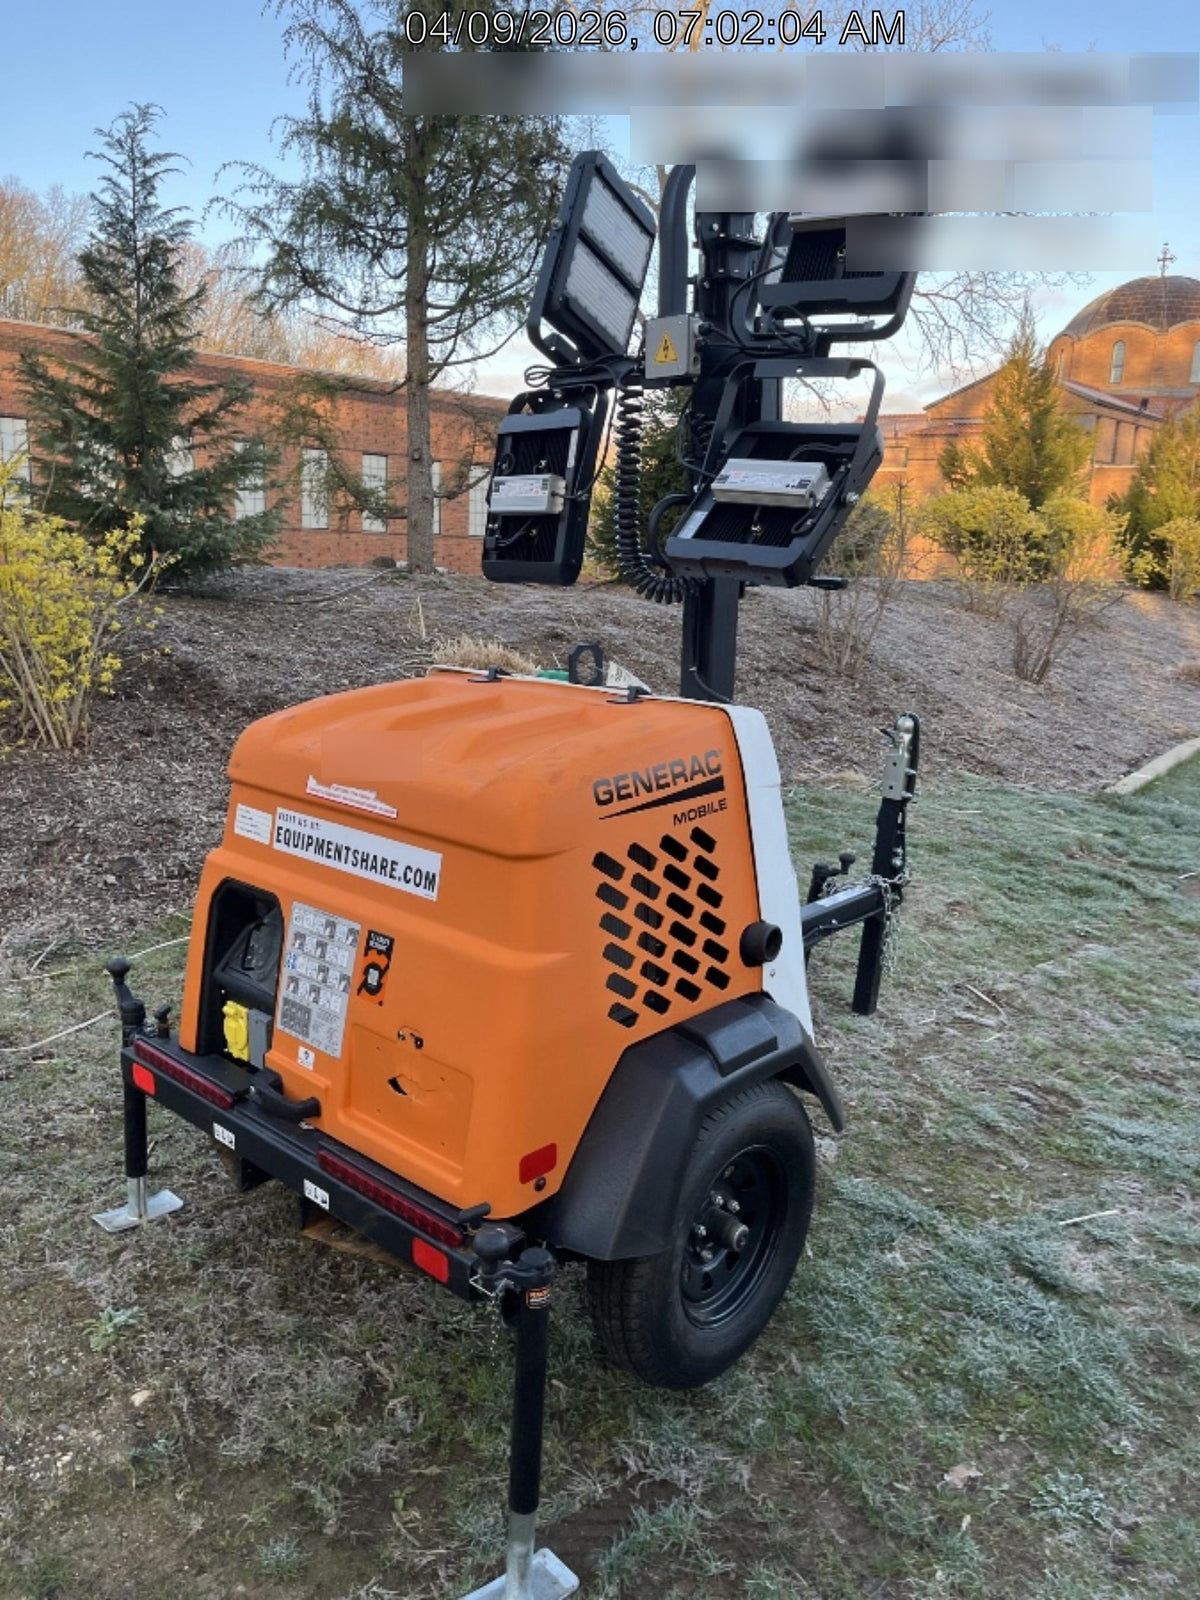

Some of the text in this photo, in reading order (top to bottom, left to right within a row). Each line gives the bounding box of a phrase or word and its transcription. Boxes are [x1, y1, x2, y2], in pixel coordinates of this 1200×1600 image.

[592, 749, 722, 806] GENERAC
[673, 798, 727, 826] MOBILE
[276, 826, 437, 893] EQUIPMENTSHARE.COM
